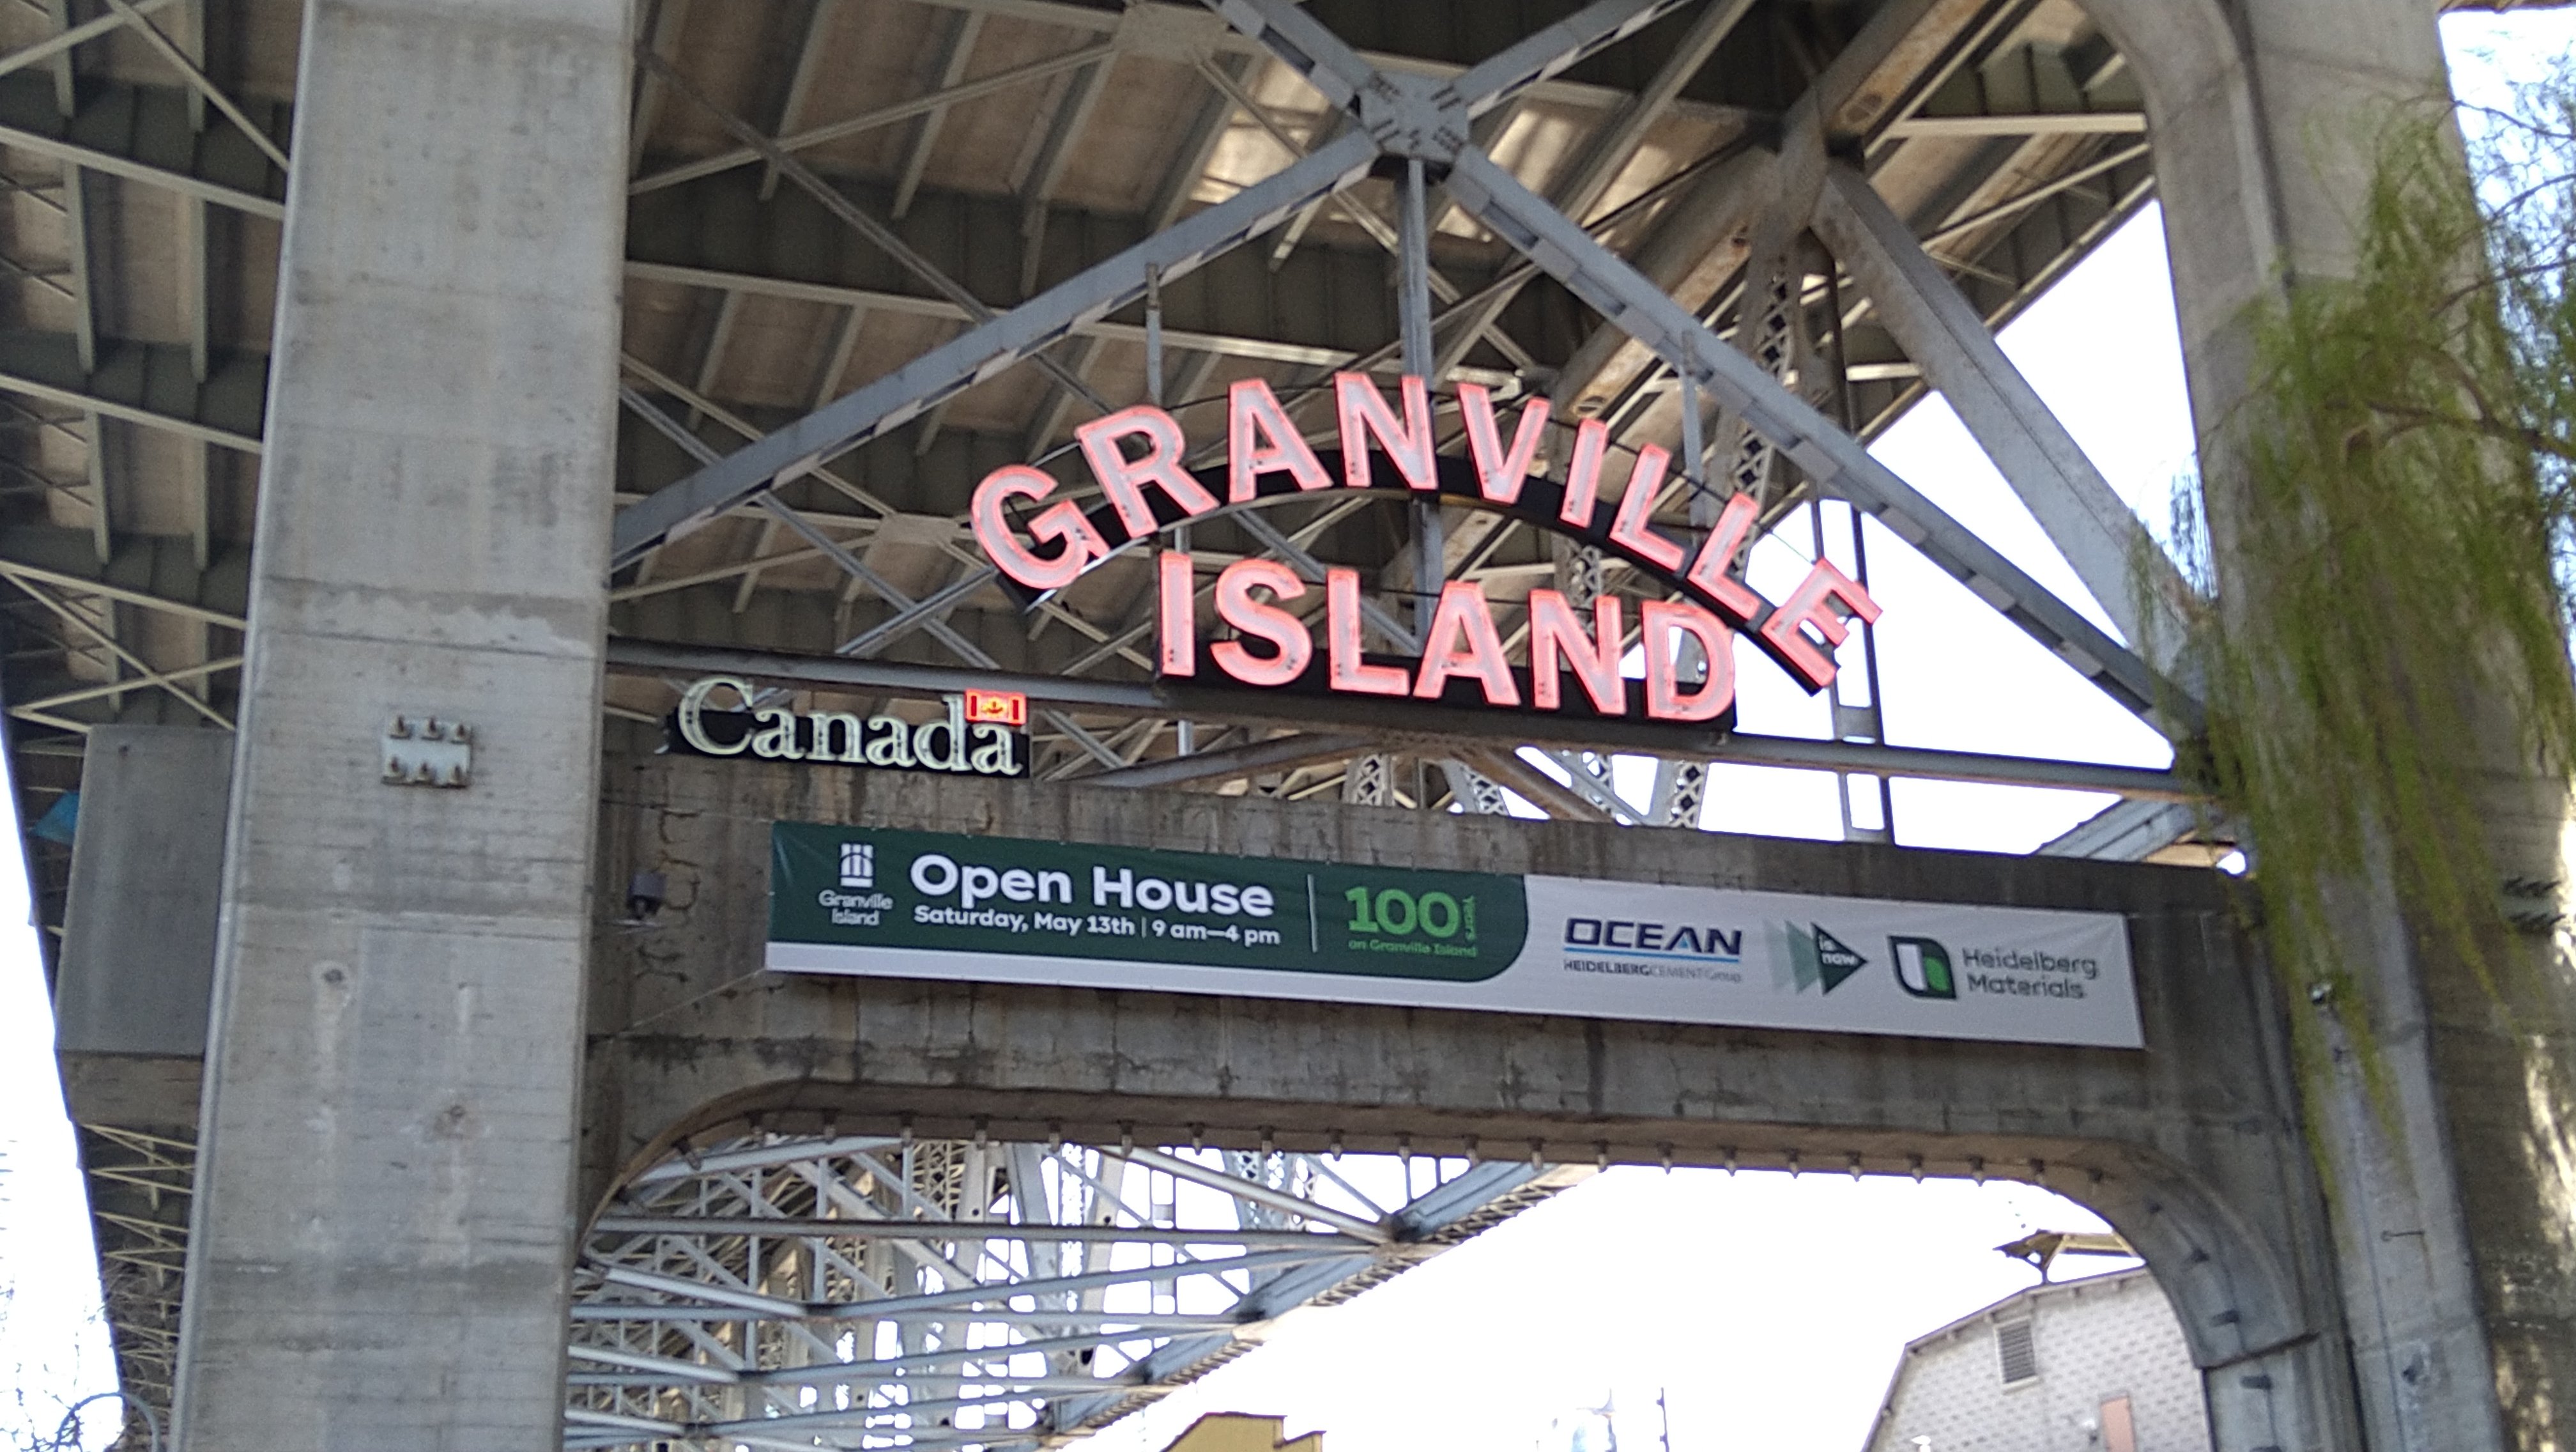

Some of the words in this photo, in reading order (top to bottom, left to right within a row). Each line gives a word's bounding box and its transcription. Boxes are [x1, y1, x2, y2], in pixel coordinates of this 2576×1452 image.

[970, 371, 1882, 688] GRANVILLE
[1160, 550, 1735, 720] ISLAND
[678, 676, 1023, 776] Canada
[819, 890, 893, 910] Granville
[910, 854, 1073, 909] Open
[1092, 866, 1275, 917] House
[832, 908, 880, 925] Island
[914, 905, 1028, 932] Saturday,
[1034, 911, 1082, 936] May
[1087, 915, 1135, 936] 13th
[1345, 886, 1459, 938] 100
[1151, 919, 1167, 938] 9
[1244, 929, 1280, 947] pm
[1348, 939, 1367, 950] on
[1369, 939, 1431, 954] Granville
[1564, 918, 1742, 955] OCEAN
[1821, 952, 1857, 966] now
[1962, 948, 2096, 980] Heidelberg
[1967, 974, 2085, 999] Materials
